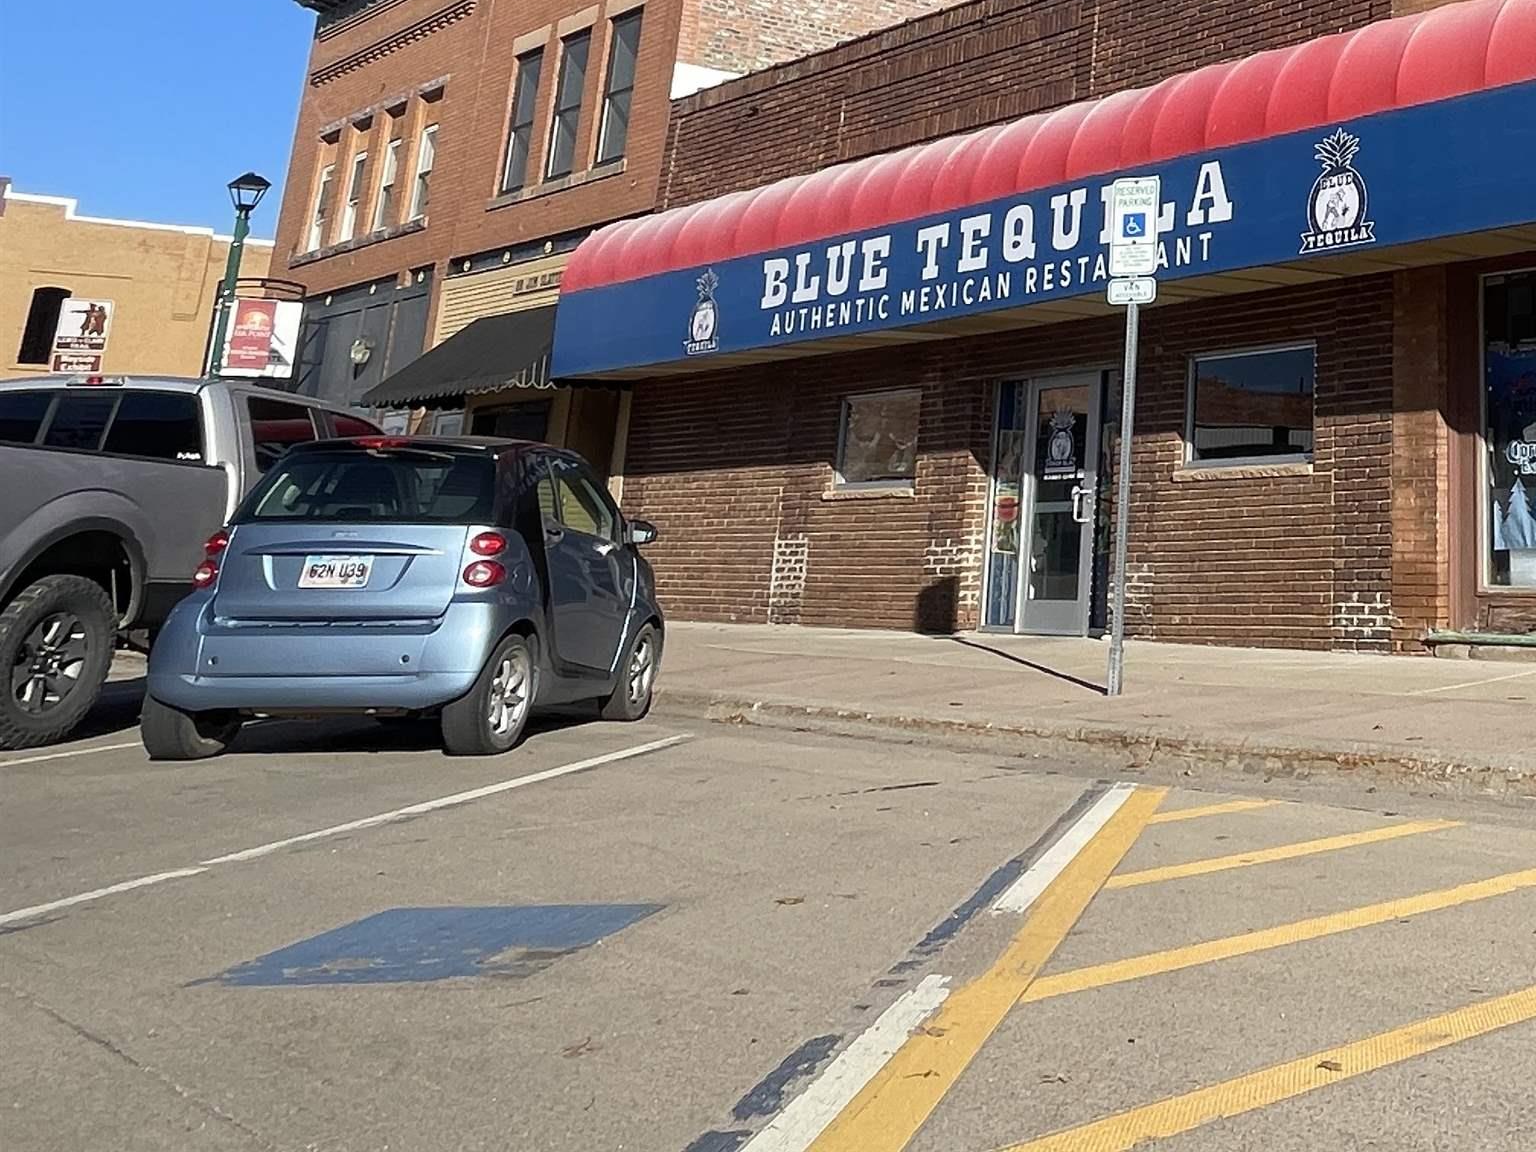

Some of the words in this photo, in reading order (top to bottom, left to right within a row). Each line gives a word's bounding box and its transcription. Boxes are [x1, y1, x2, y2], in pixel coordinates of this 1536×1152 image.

[1115, 185, 1155, 197] RESERVED
[1119, 197, 1152, 208] PARKING
[1306, 226, 1369, 249] TEQUILA
[761, 235, 891, 309] BLUE
[770, 294, 890, 337] AUTHENTIC
[901, 271, 1010, 316] MEXICAN
[1025, 232, 1213, 295] RESTAANT
[1123, 283, 1140, 291] VAN
